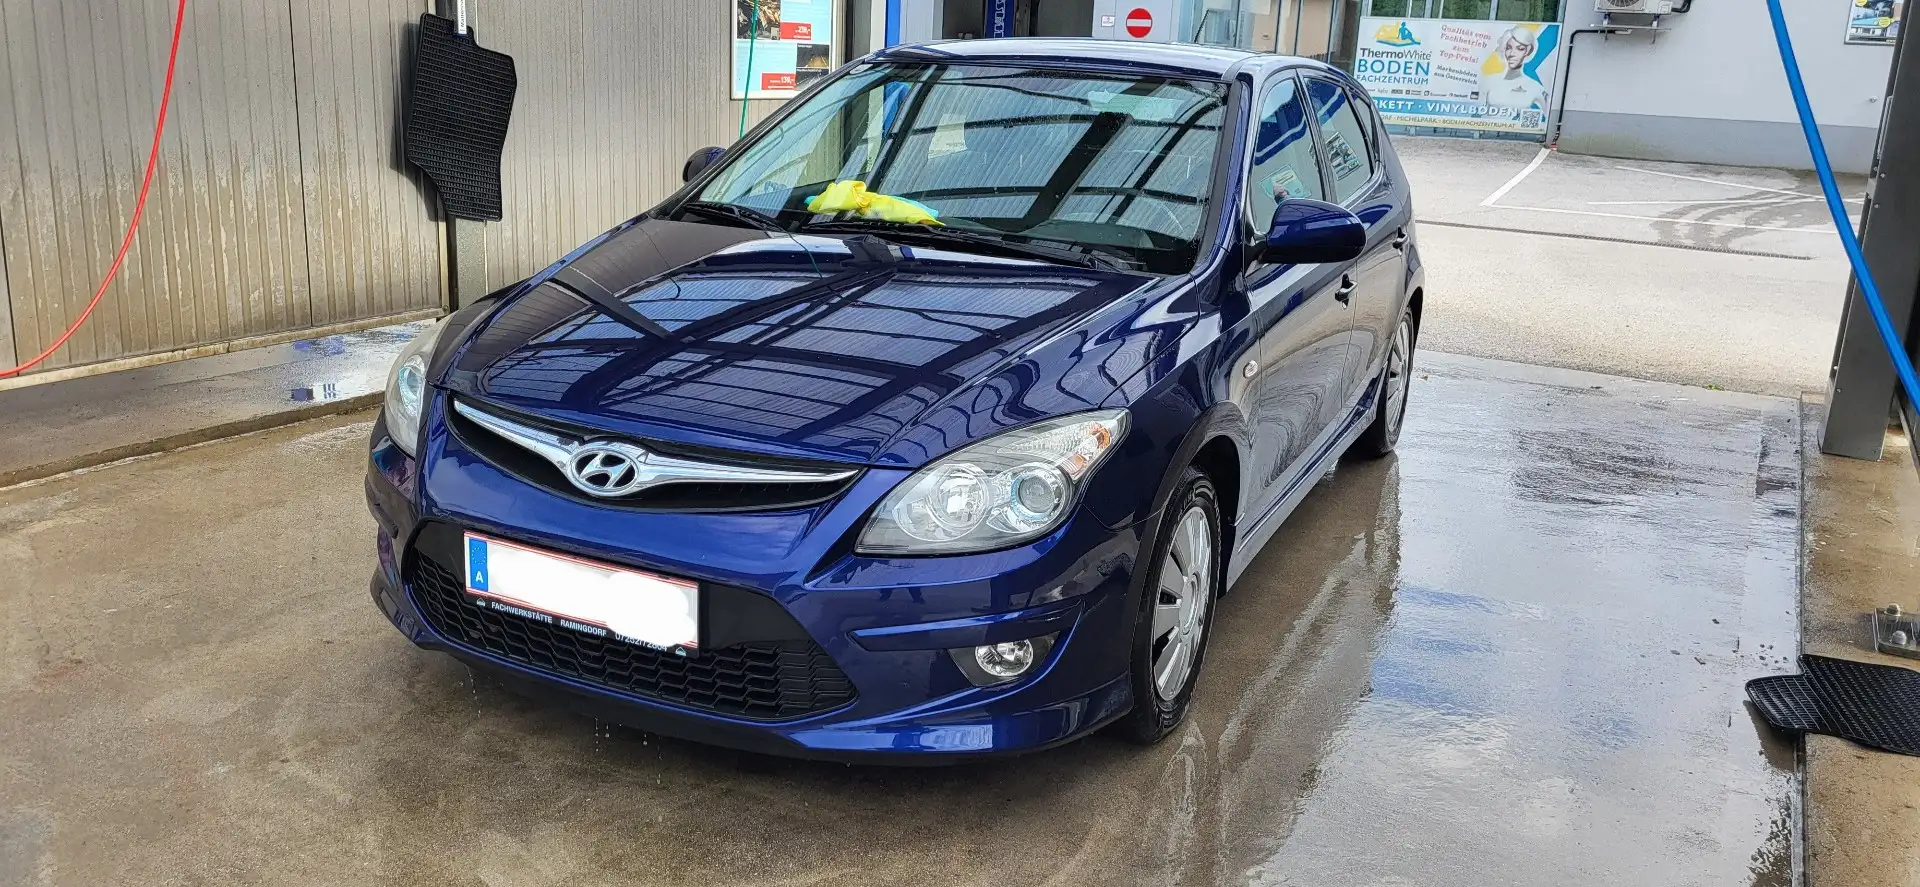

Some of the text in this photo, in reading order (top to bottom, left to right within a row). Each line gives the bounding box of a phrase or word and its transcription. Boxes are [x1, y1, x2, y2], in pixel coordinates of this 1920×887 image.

[1441, 24, 1473, 37] Qualität
[1440, 32, 1488, 48] Fachbetrieb
[1360, 47, 1431, 60] ThermoWhite
[1439, 49, 1479, 63] Top-Preis!
[1452, 45, 1470, 53] zum
[1357, 59, 1430, 76] BODEN
[1436, 64, 1478, 78] Markenböden
[1356, 74, 1429, 85] FACHZENTRUM
[1373, 99, 1518, 118] RKETT VINYLBÖDEN
[1396, 115, 1438, 124] MICHELPARK
[475, 570, 484, 584] A
[491, 601, 553, 624] FACHWERKSTÄTTE
[560, 618, 607, 637] RAMINGDORF
